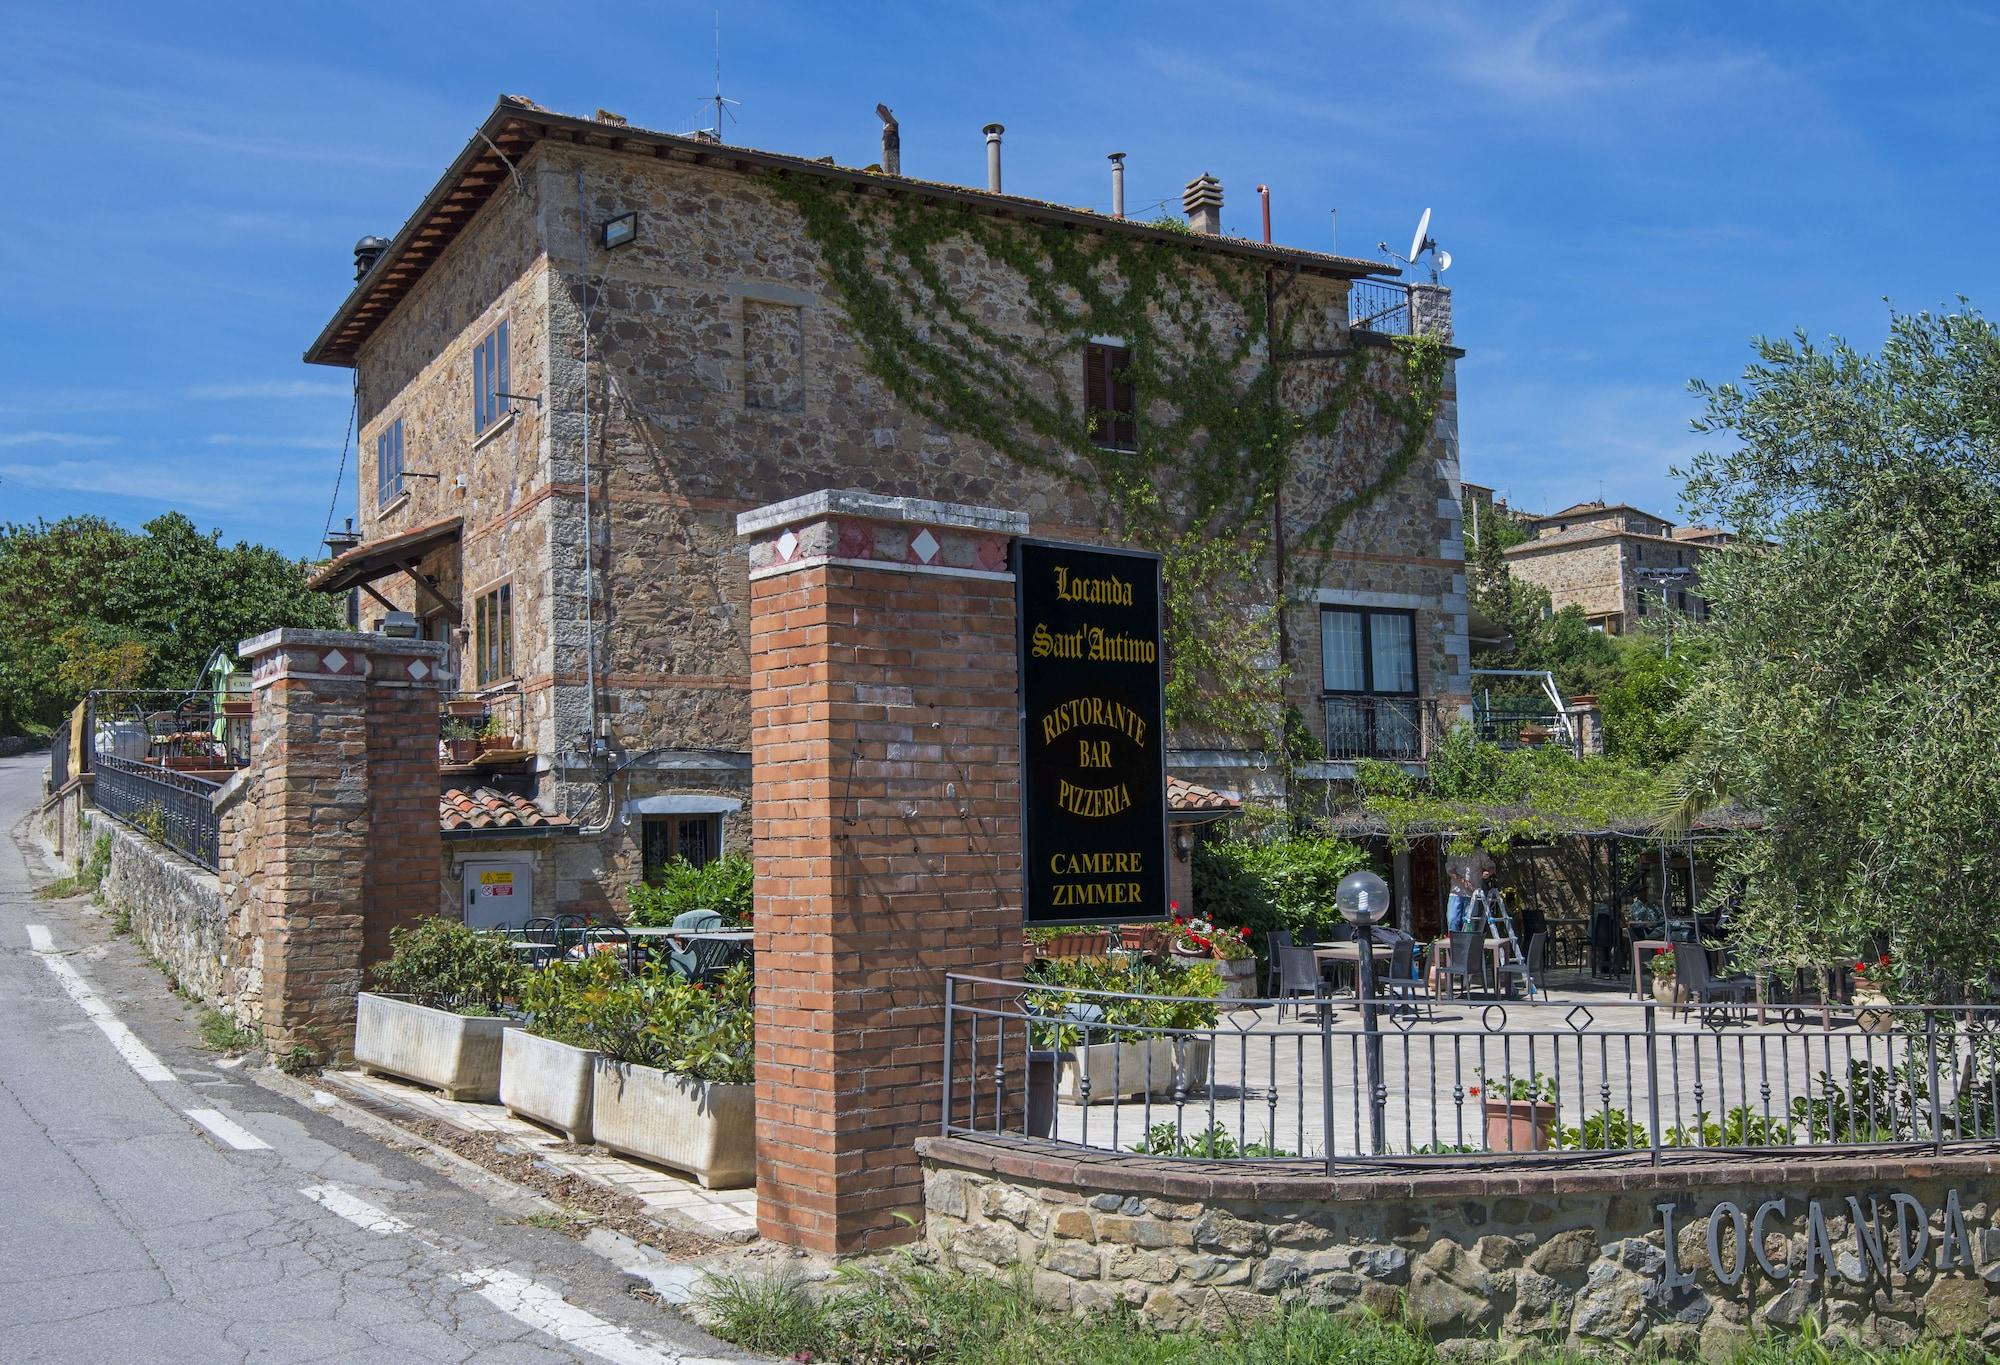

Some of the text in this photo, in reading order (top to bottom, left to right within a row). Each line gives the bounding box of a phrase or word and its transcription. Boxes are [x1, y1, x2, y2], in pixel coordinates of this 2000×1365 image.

[1054, 566, 1133, 606] Locanda
[1032, 623, 1155, 664] Sant'Antimo
[1042, 697, 1146, 748] RISTORANTE
[1079, 740, 1112, 768] BAR
[1058, 779, 1131, 817] PIZZERIA
[1051, 852, 1142, 874] CAMERE
[1052, 883, 1142, 906] ZIMMER
[1656, 1189, 1974, 1288] LOCANDA
